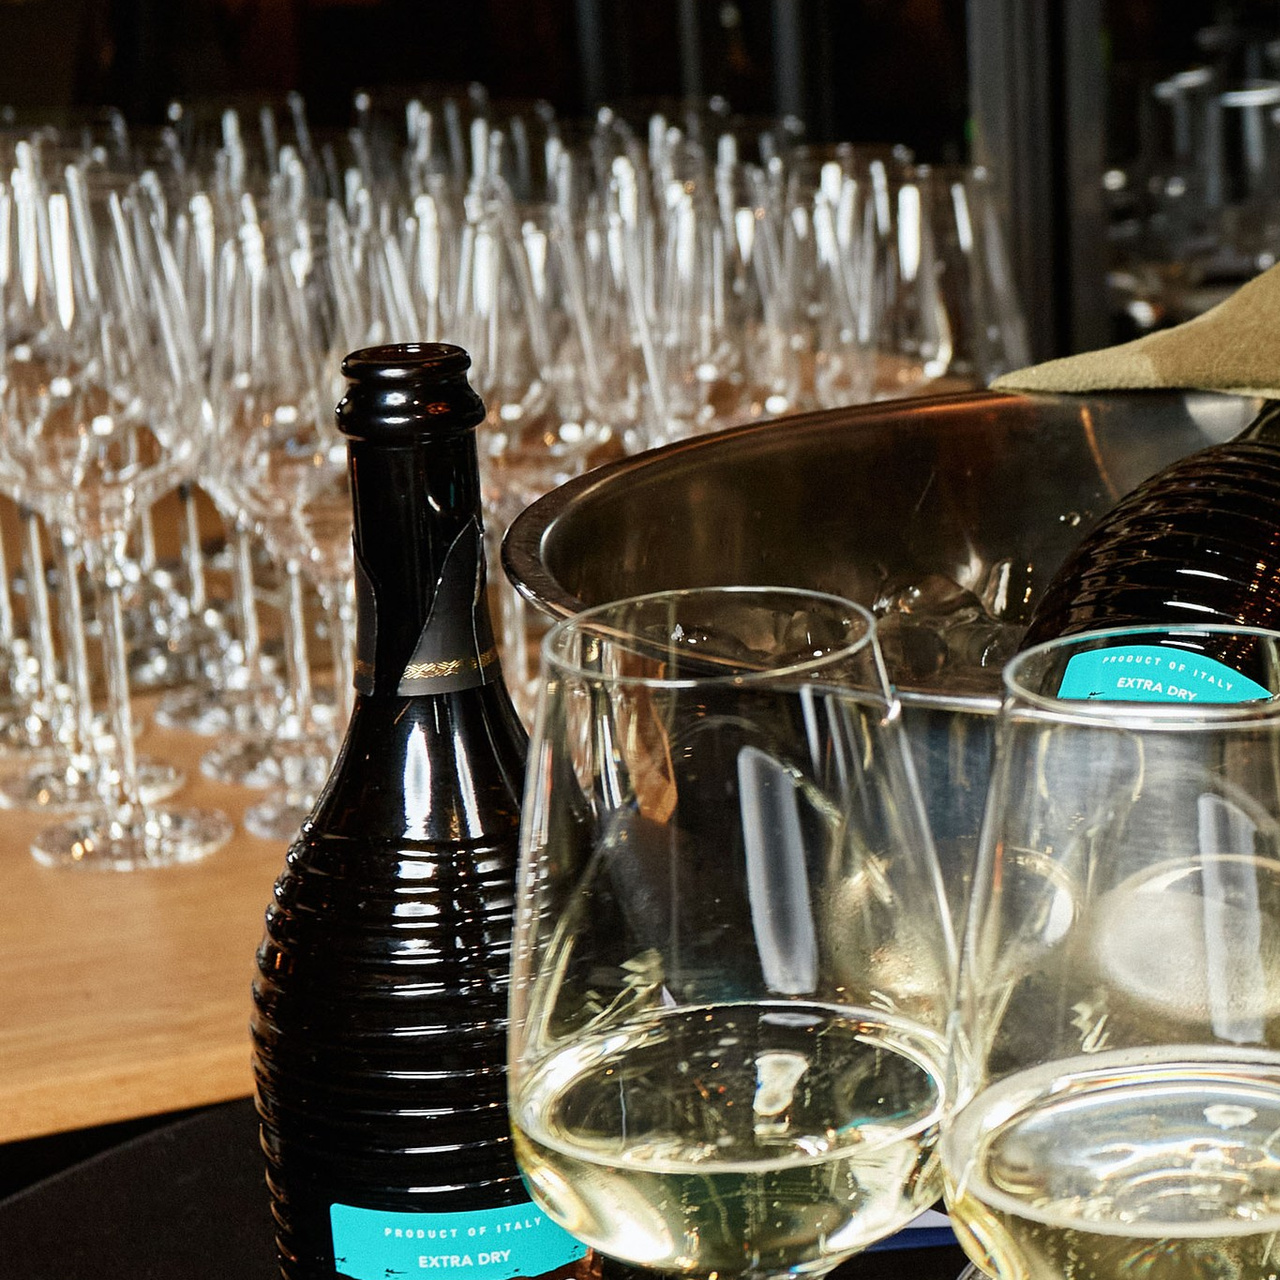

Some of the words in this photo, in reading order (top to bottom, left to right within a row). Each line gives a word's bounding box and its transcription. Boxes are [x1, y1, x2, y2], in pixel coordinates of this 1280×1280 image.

[1102, 655, 1161, 665] PRODUCT
[1168, 661, 1186, 672] OF
[1193, 669, 1233, 692] ITALY
[1116, 677, 1163, 693] EXTRA
[1167, 685, 1197, 701] DRY
[384, 1227, 458, 1239] PRODUCT
[467, 1226, 487, 1237] OF
[496, 1216, 541, 1234] ITALY
[418, 1254, 473, 1269] EXTRA
[478, 1249, 511, 1265] DRY
